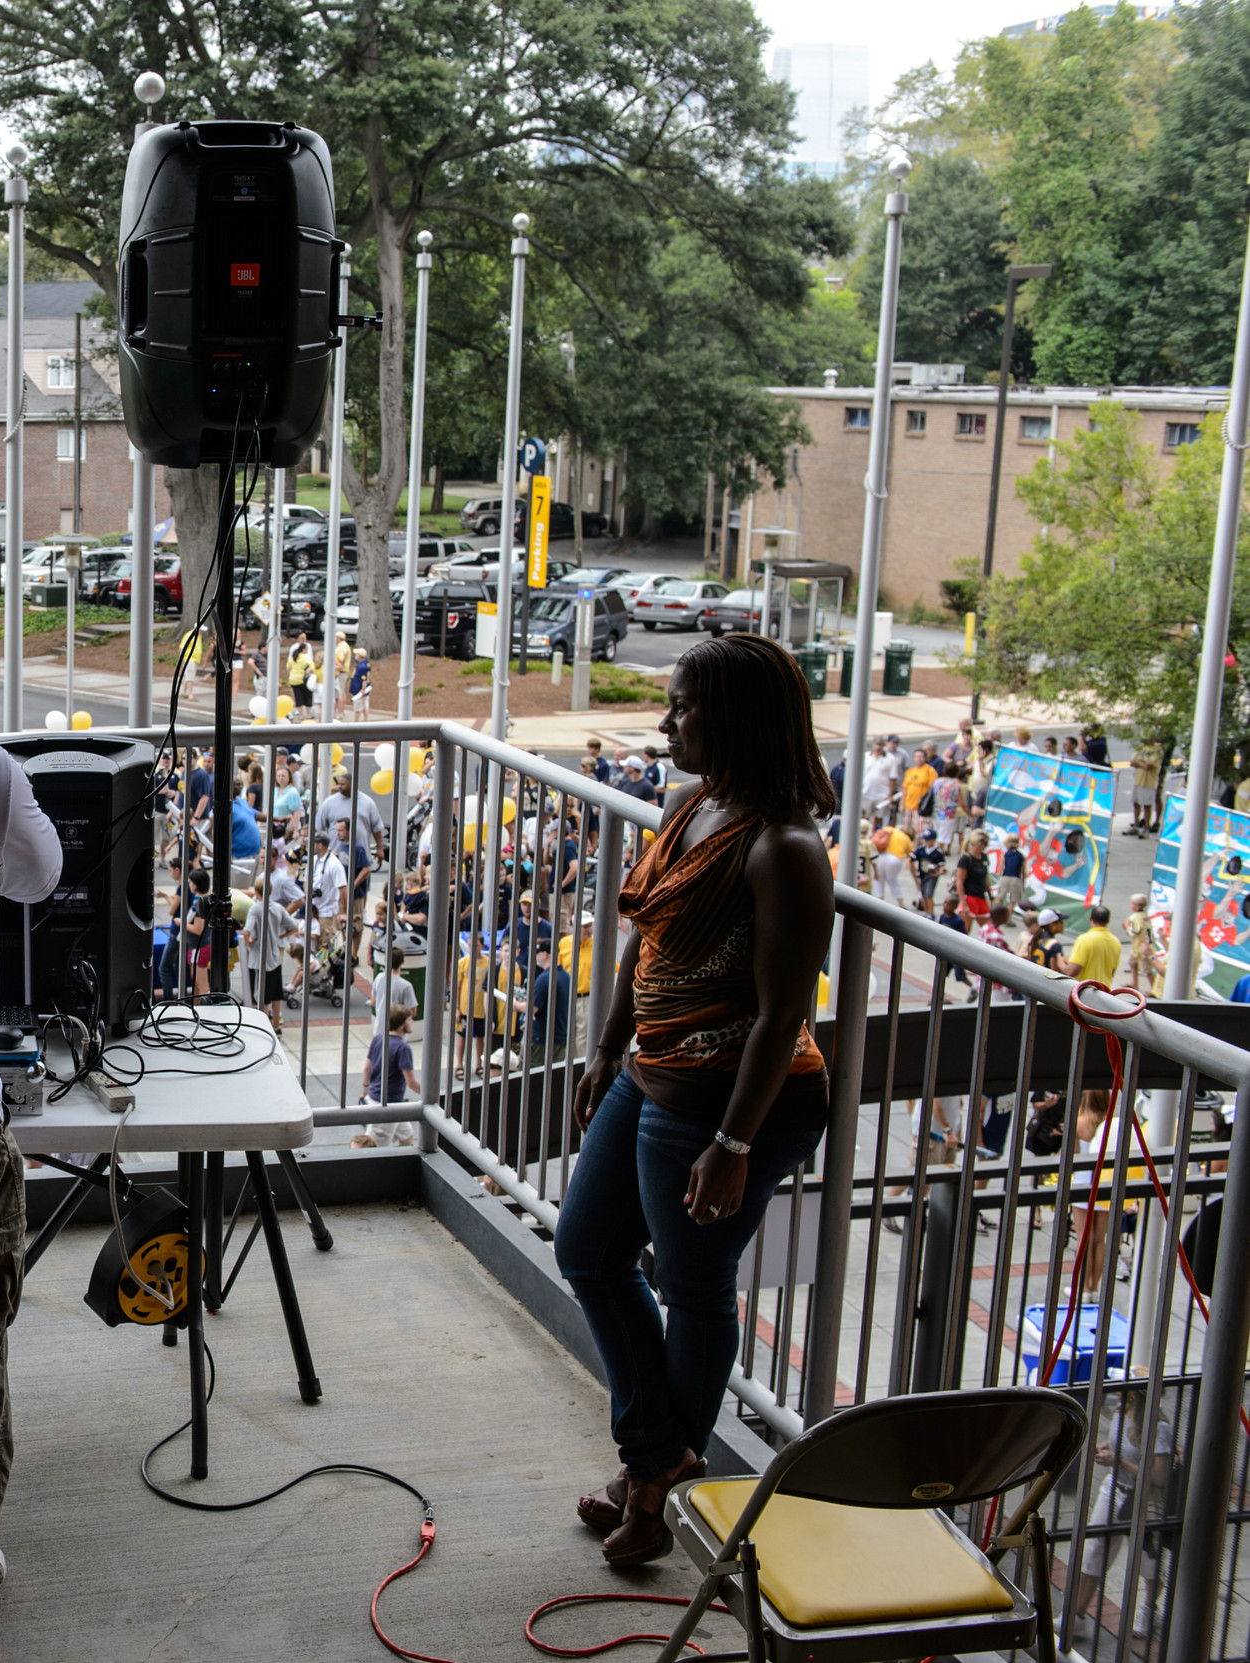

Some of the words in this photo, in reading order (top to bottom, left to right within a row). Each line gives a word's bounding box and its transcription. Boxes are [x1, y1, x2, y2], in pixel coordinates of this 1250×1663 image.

[237, 269, 254, 281] JBL
[524, 443, 537, 467] P
[536, 495, 544, 515] 7
[532, 522, 545, 581] Parking
